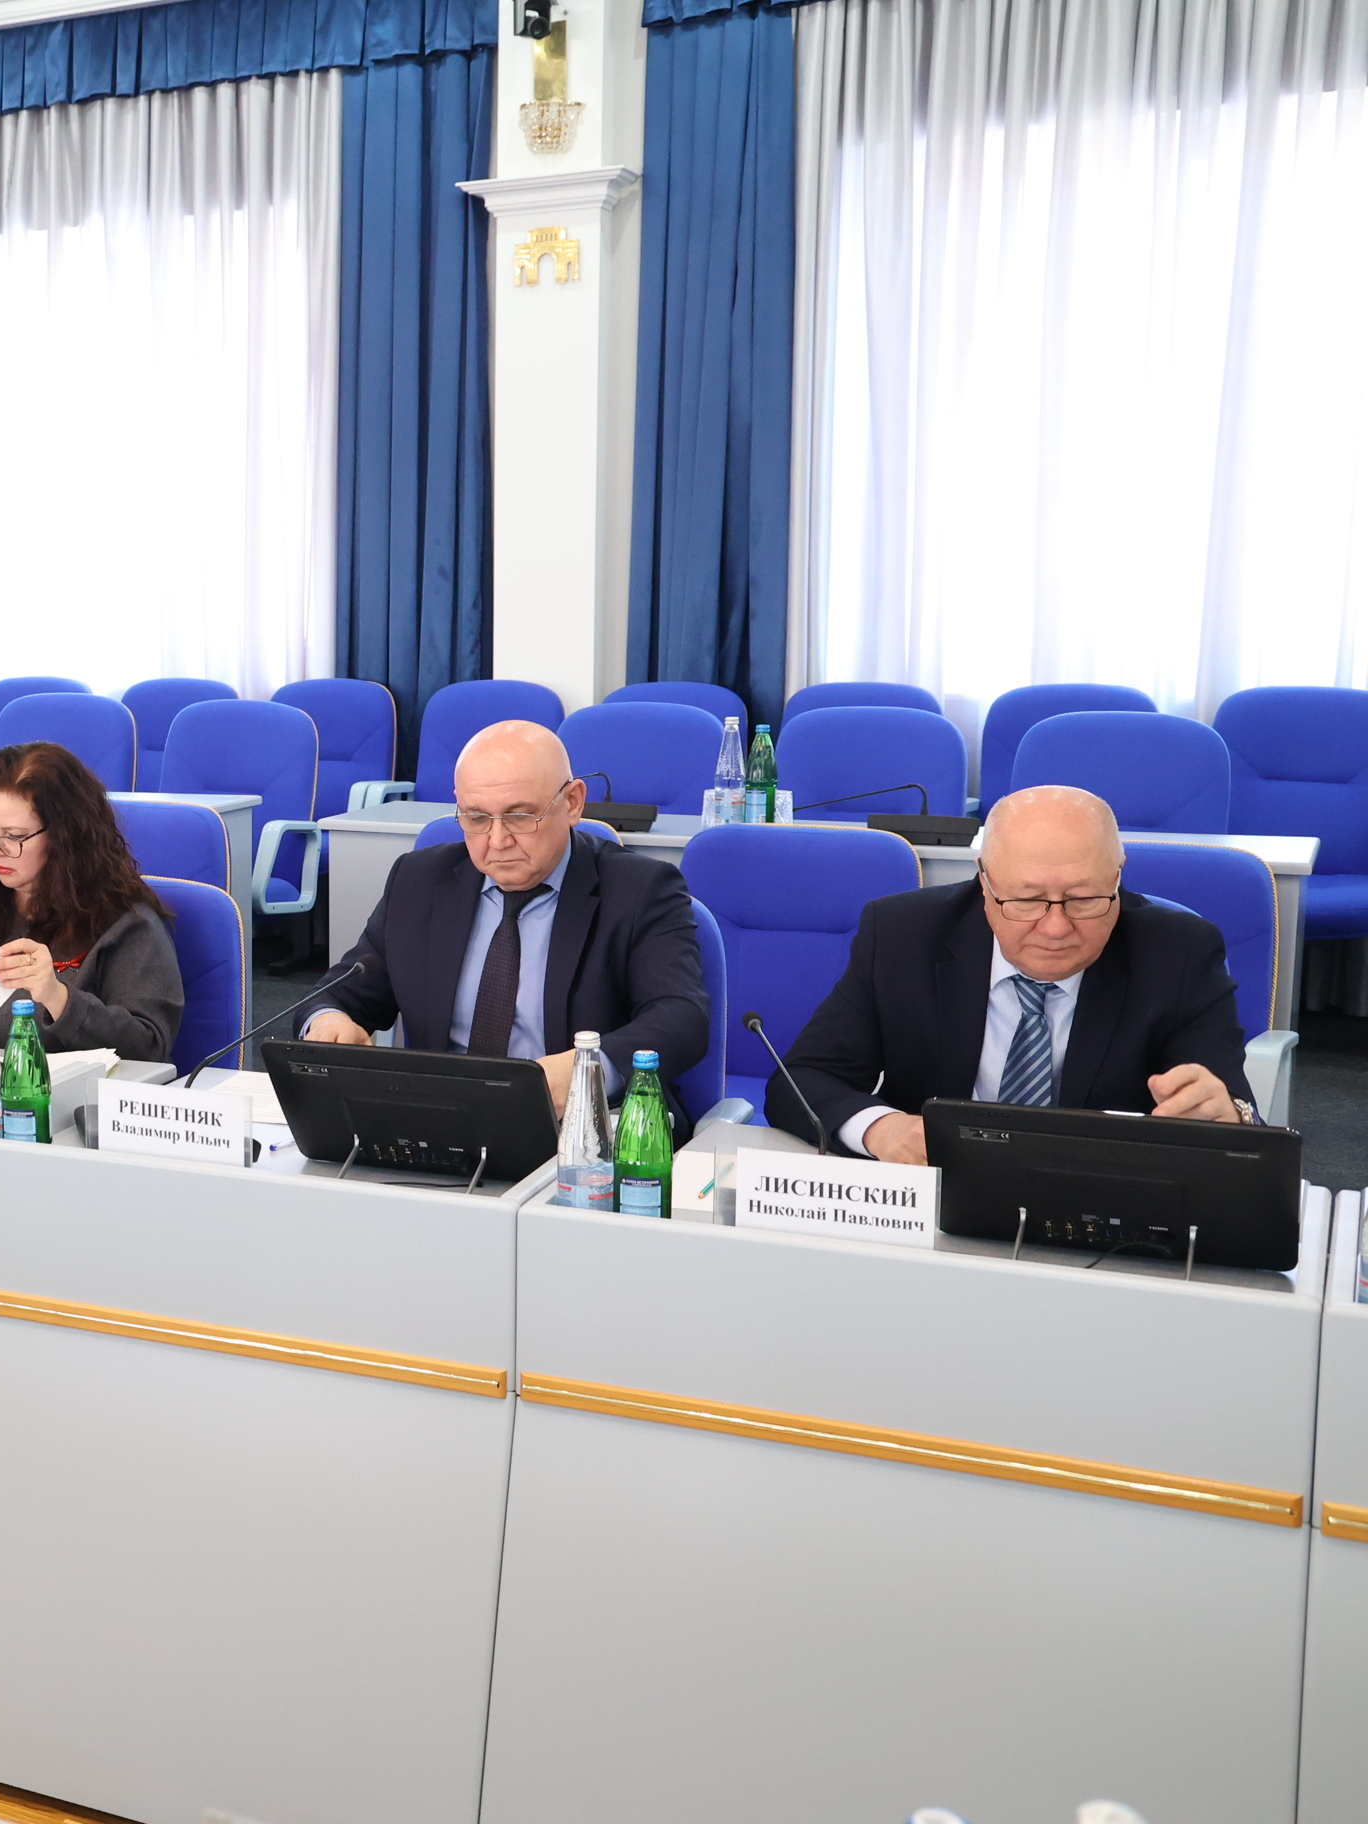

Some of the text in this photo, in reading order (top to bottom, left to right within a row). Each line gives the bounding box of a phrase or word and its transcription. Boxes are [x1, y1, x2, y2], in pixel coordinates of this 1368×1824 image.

[119, 1100, 223, 1127] РЕШЕТНЯК
[112, 1120, 230, 1148] Владимир Ильич
[755, 1176, 917, 1208] ЛИСИНСКИЙ
[748, 1199, 924, 1232] Николай Павлович
